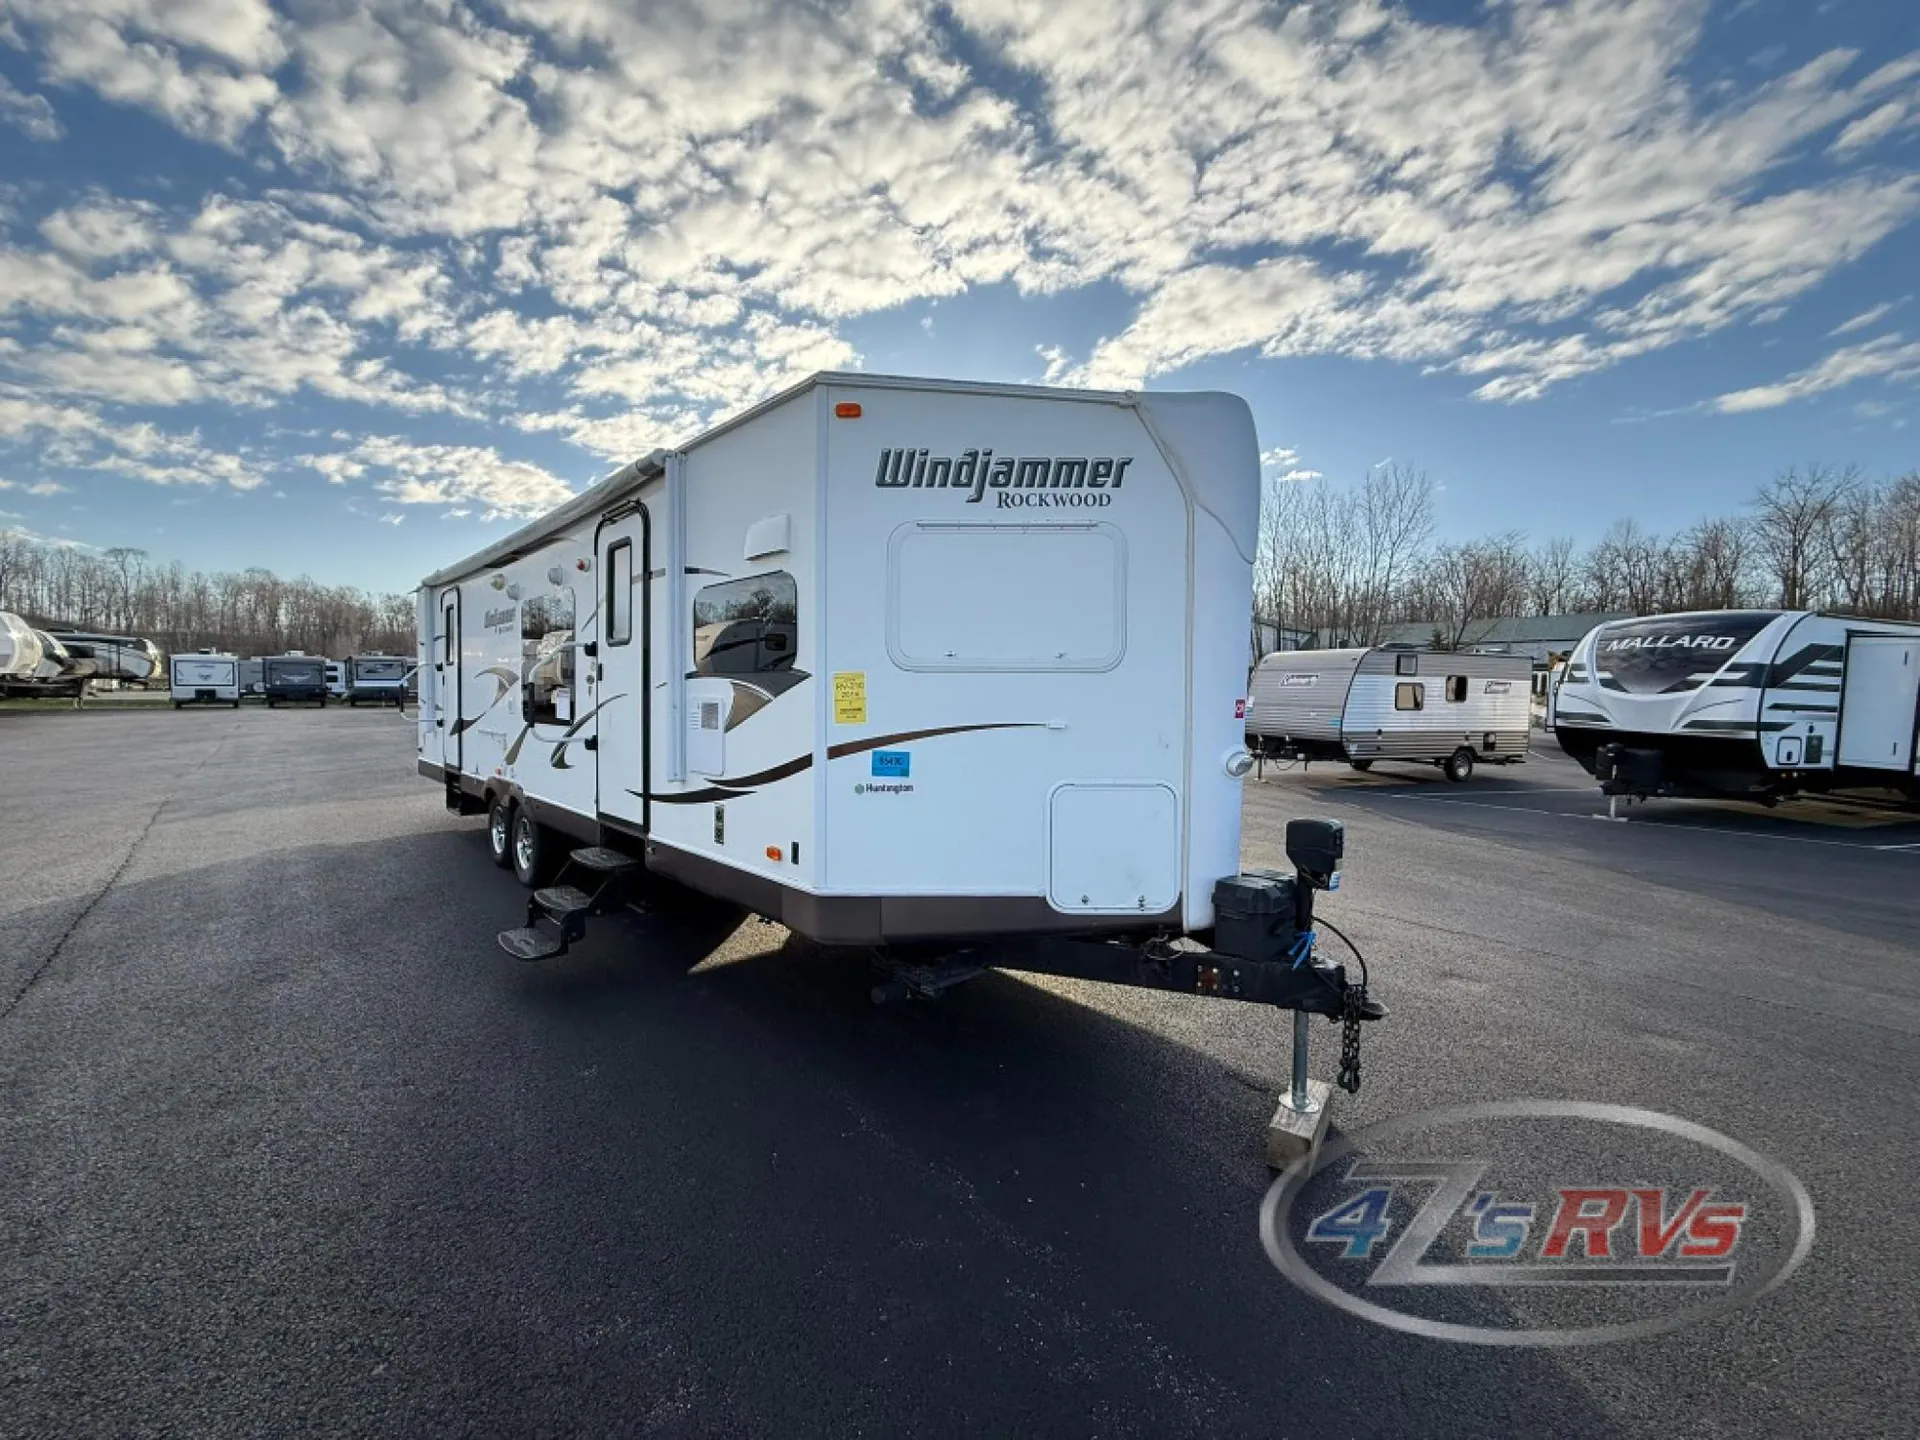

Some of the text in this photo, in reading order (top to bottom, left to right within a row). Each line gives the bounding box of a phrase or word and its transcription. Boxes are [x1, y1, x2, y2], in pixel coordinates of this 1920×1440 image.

[875, 447, 1134, 503] Windjammer
[997, 491, 1112, 509] ROCKWOOD
[1606, 635, 1736, 652] MALLARD
